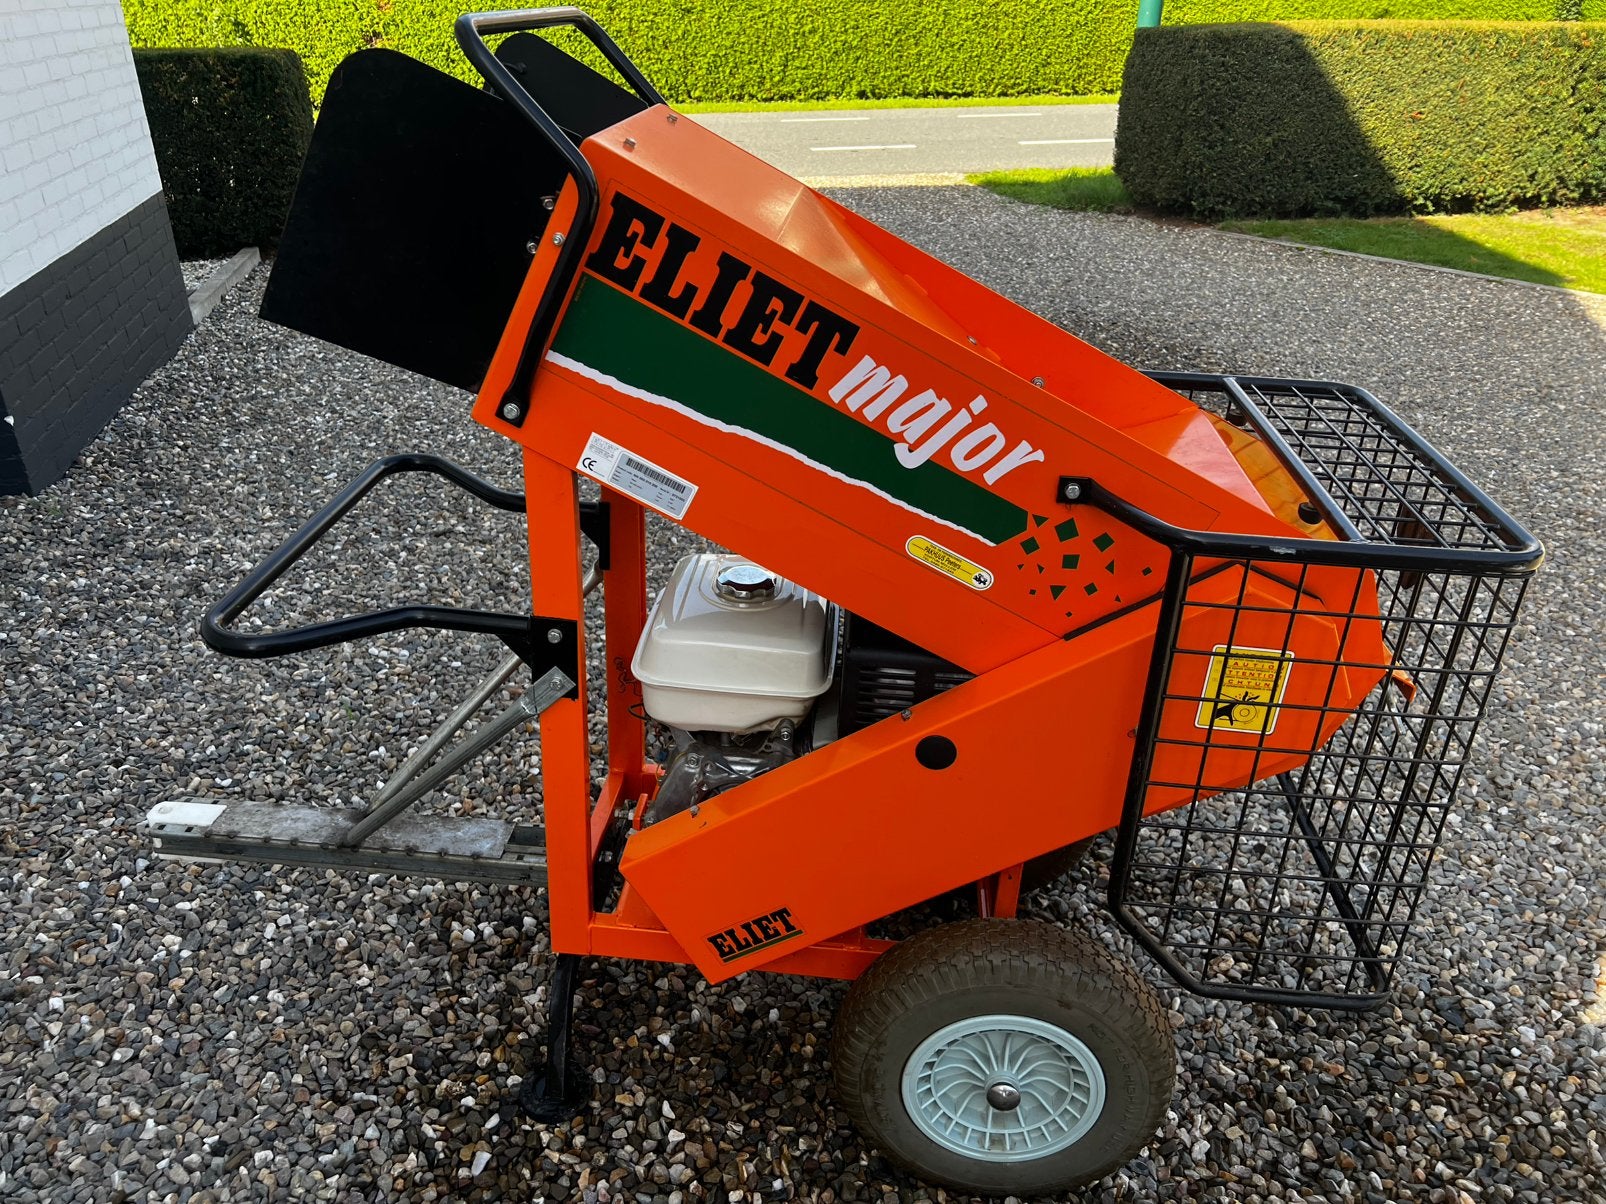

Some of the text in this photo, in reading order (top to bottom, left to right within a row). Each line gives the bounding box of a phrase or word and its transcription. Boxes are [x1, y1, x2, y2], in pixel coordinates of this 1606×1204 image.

[585, 191, 1045, 486] ELIET major
[707, 907, 797, 958] ELIET
